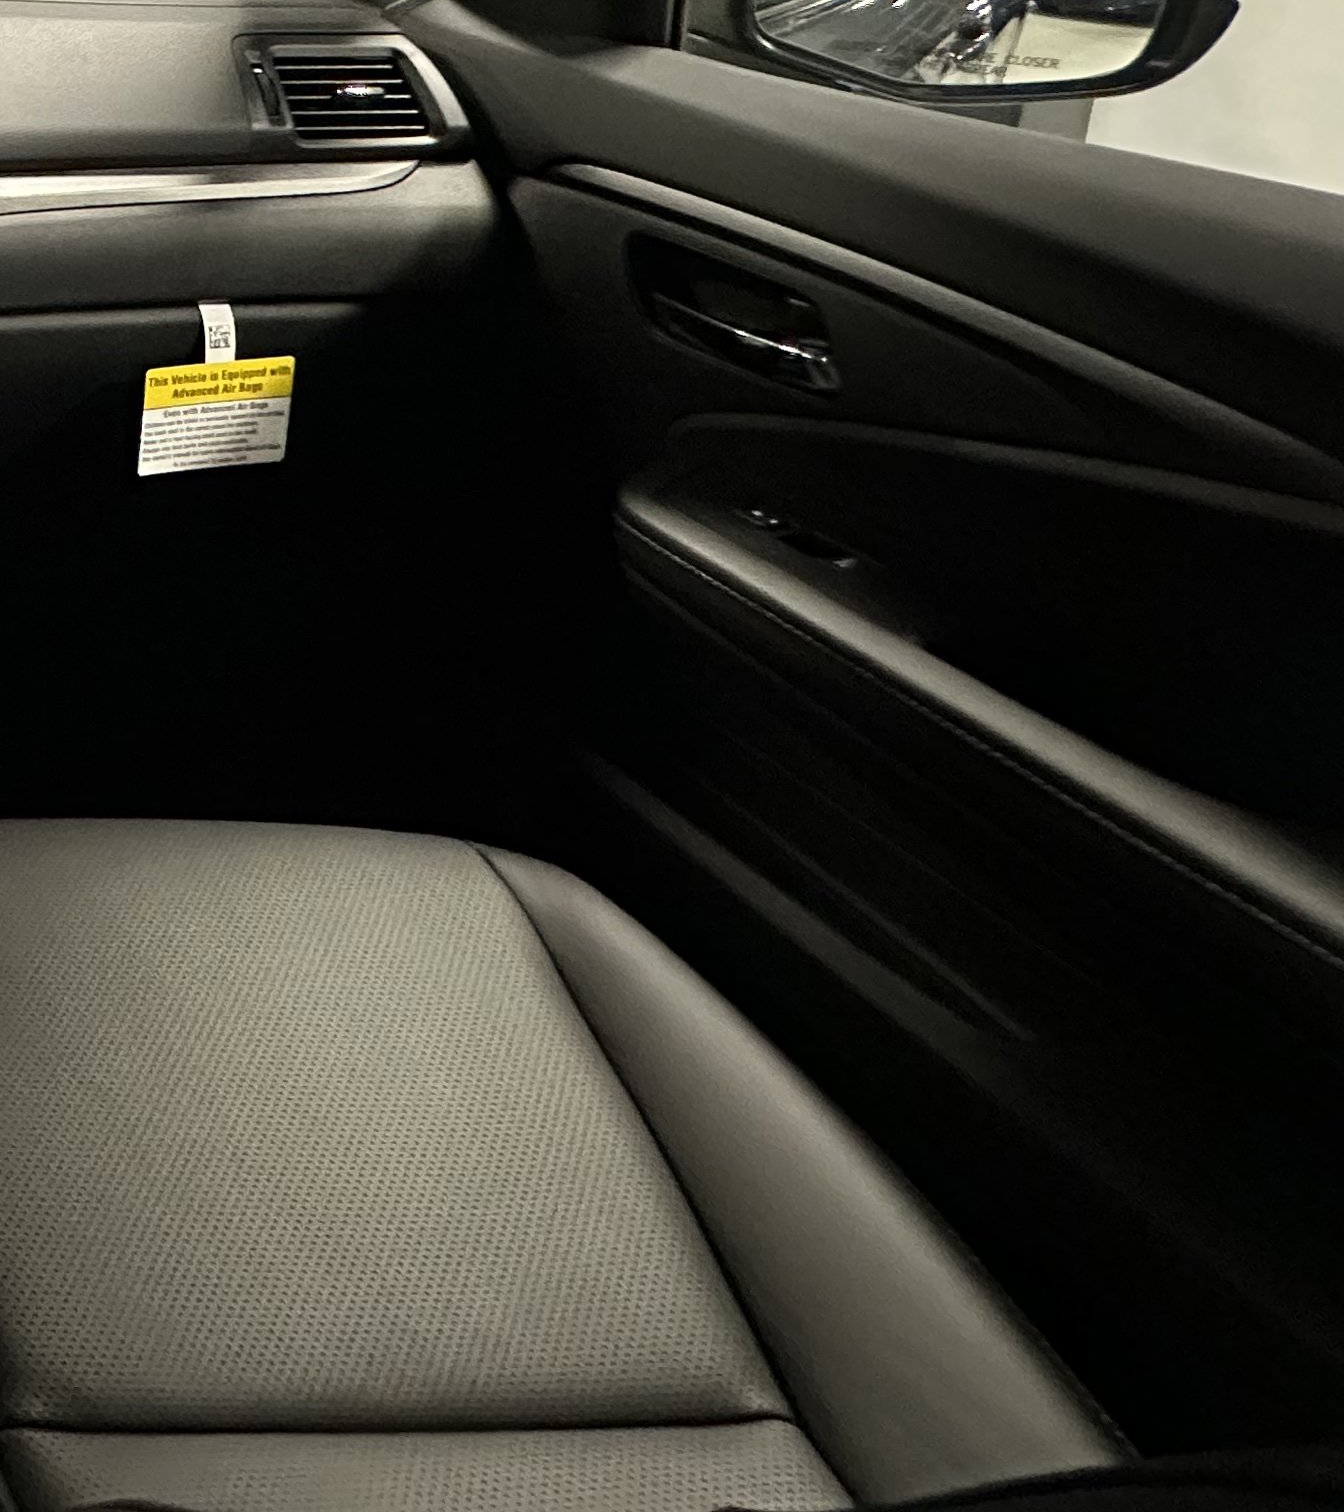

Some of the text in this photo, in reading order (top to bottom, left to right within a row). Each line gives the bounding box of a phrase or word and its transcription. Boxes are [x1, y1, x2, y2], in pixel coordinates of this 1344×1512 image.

[149, 366, 291, 388] This Vehicle is Equipped with
[172, 383, 264, 399] Advanced Air Bags
